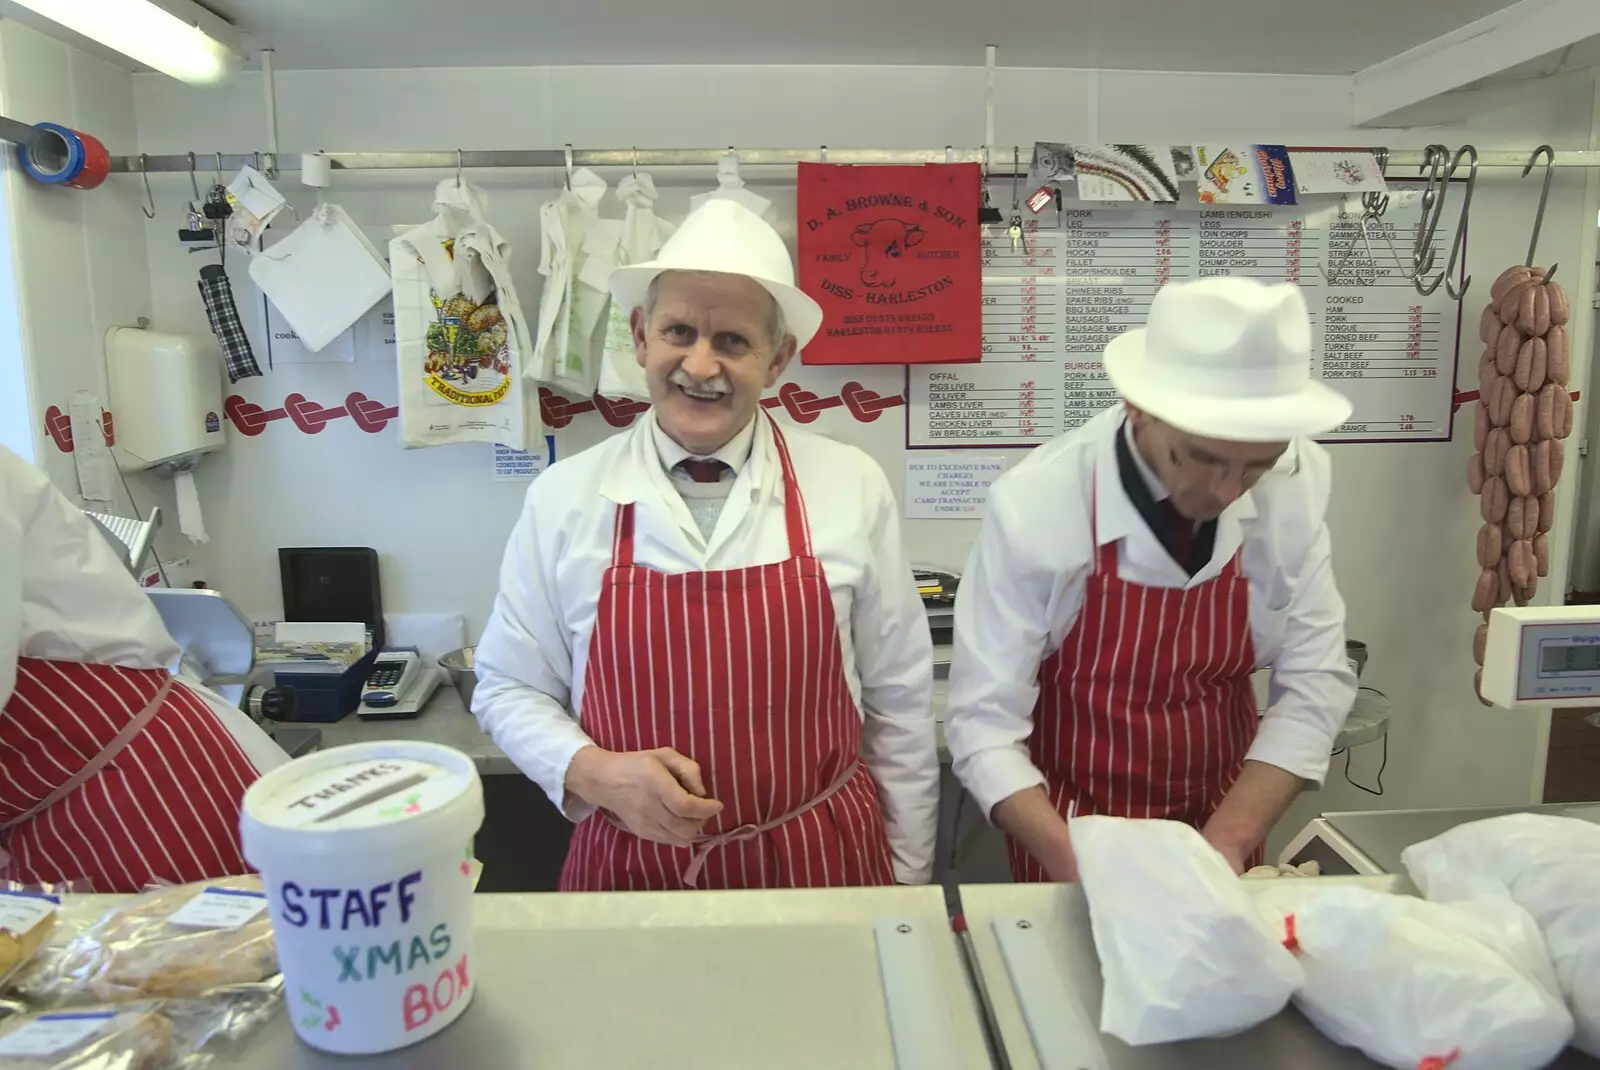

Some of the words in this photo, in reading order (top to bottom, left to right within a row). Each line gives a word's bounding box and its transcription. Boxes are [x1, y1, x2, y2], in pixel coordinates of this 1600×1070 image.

[846, 193, 913, 212] BROWNE
[918, 201, 928, 212] &
[934, 206, 967, 229] SON
[1066, 210, 1093, 218] PORK
[1066, 221, 1083, 229] LEG
[1200, 221, 1221, 229] LEGS
[1067, 230, 1083, 238] LEG
[1220, 230, 1248, 238] CHOPS
[1066, 240, 1099, 248] STEAKS
[1199, 240, 1243, 248] SHOULDER
[816, 252, 851, 262] FAMILY
[917, 251, 960, 259] BUTCHER
[1066, 249, 1096, 257] HOCKS
[1328, 250, 1364, 258] STREAKY
[821, 279, 853, 301] DISS
[866, 276, 954, 304] HARLESTON
[1066, 287, 1102, 295] CHINESE
[1104, 287, 1123, 295] RIBS
[1086, 306, 1129, 314] SAUSAGES
[1065, 325, 1104, 333] SAUSAGE
[275, 330, 300, 340] cook
[1065, 344, 1105, 352] CHIPOLAT
[1065, 362, 1104, 370] BURGER
[432, 376, 494, 404] TRADITIONAL
[929, 383, 949, 391] PIGS
[1064, 400, 1086, 408] LAMB
[287, 762, 403, 810] THANKS
[281, 870, 422, 930] STAFF
[333, 923, 452, 983] XMAS
[403, 953, 470, 1032] BOX
